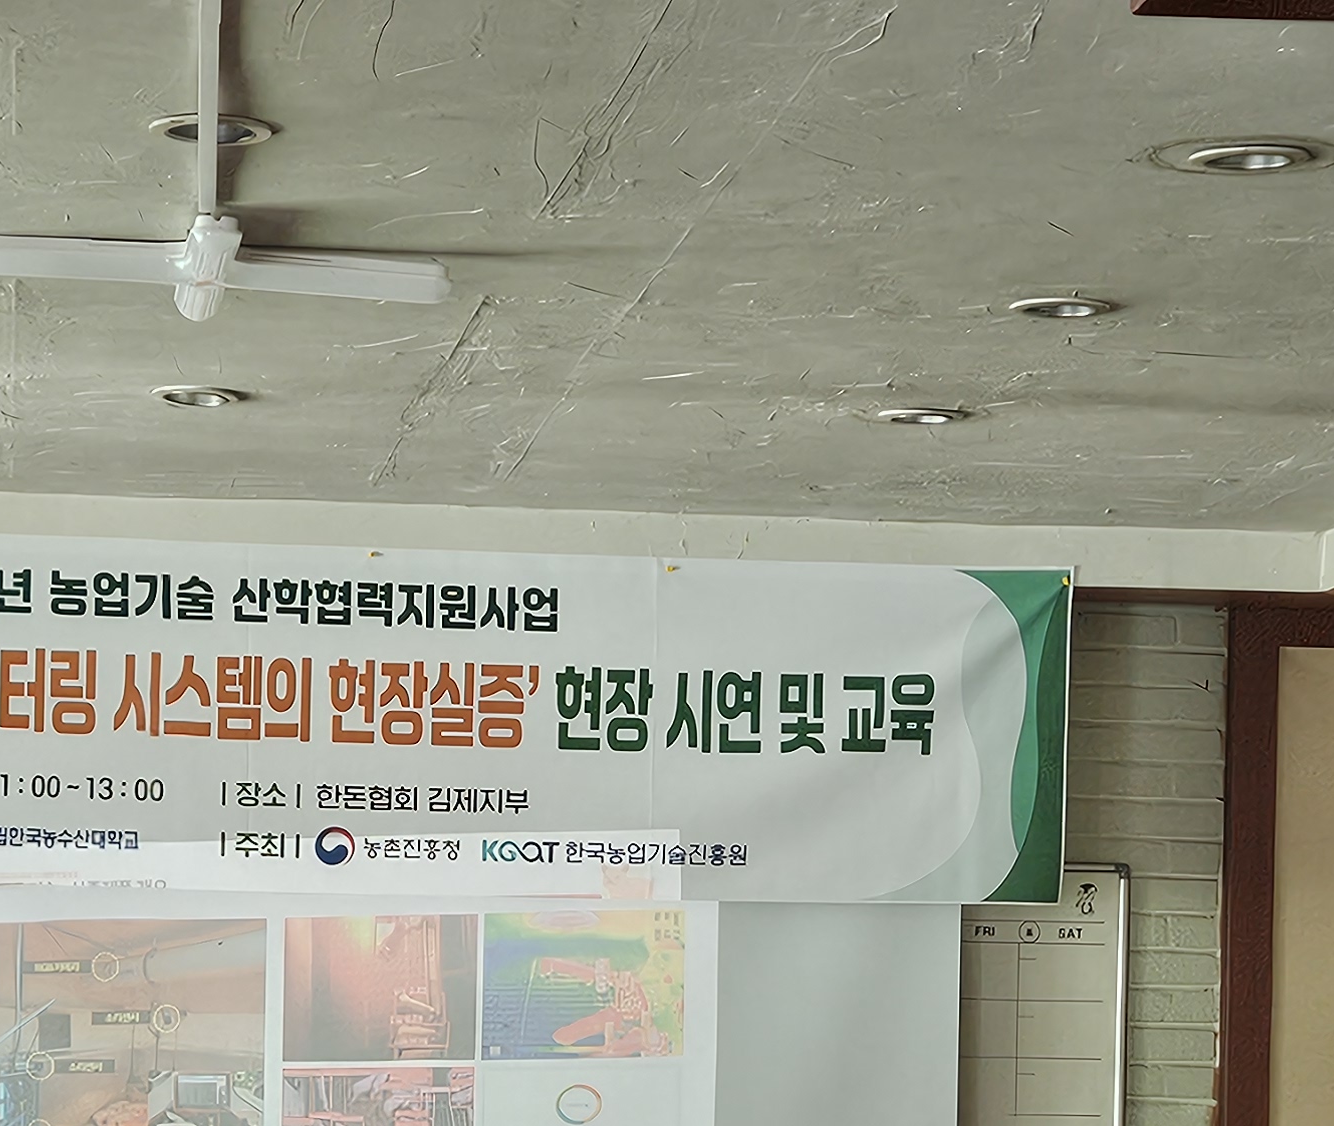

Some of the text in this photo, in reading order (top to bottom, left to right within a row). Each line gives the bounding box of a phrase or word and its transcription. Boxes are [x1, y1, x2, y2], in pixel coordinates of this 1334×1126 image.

[50, 570, 214, 620] 농업기술
[233, 578, 558, 632] 산학협력지원사업
[114, 652, 312, 742] 시스템의
[556, 666, 653, 751] 현장
[666, 670, 761, 753] 시연
[780, 673, 825, 753] 및
[842, 674, 934, 755] 교육
[236, 783, 529, 814] 장소 한돈협회 김제지부
[235, 832, 286, 858] 주최
[364, 838, 460, 860] 농촌진흥청
[566, 842, 747, 866] 한국농업기술진흥원
[975, 926, 995, 936] FRI
[1059, 928, 1082, 939] SAT
